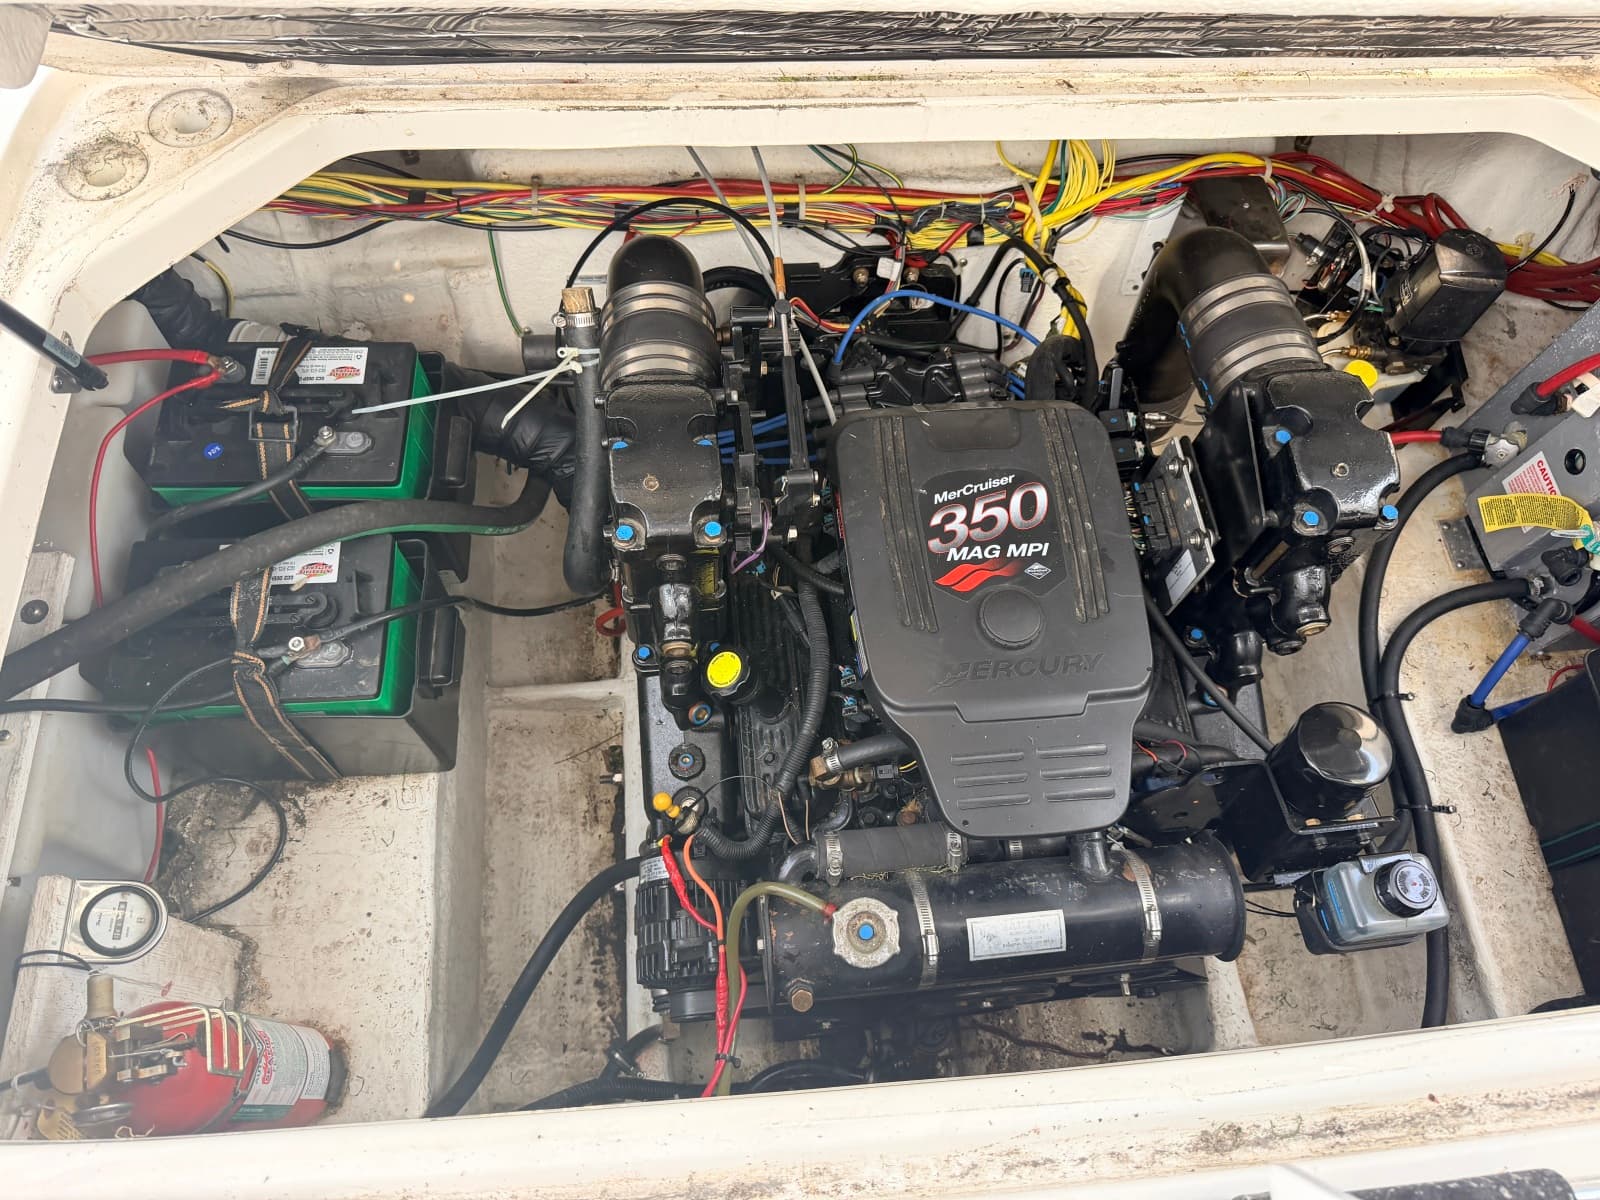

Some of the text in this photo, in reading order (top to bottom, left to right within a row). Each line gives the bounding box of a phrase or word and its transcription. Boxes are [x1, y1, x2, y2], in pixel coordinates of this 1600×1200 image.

[934, 474, 1015, 505] MerCruiser
[1536, 460, 1557, 496] CAUTIO
[927, 481, 1049, 554] 350
[946, 542, 1050, 562] MAG MPI
[935, 652, 1105, 687] MERCURY
